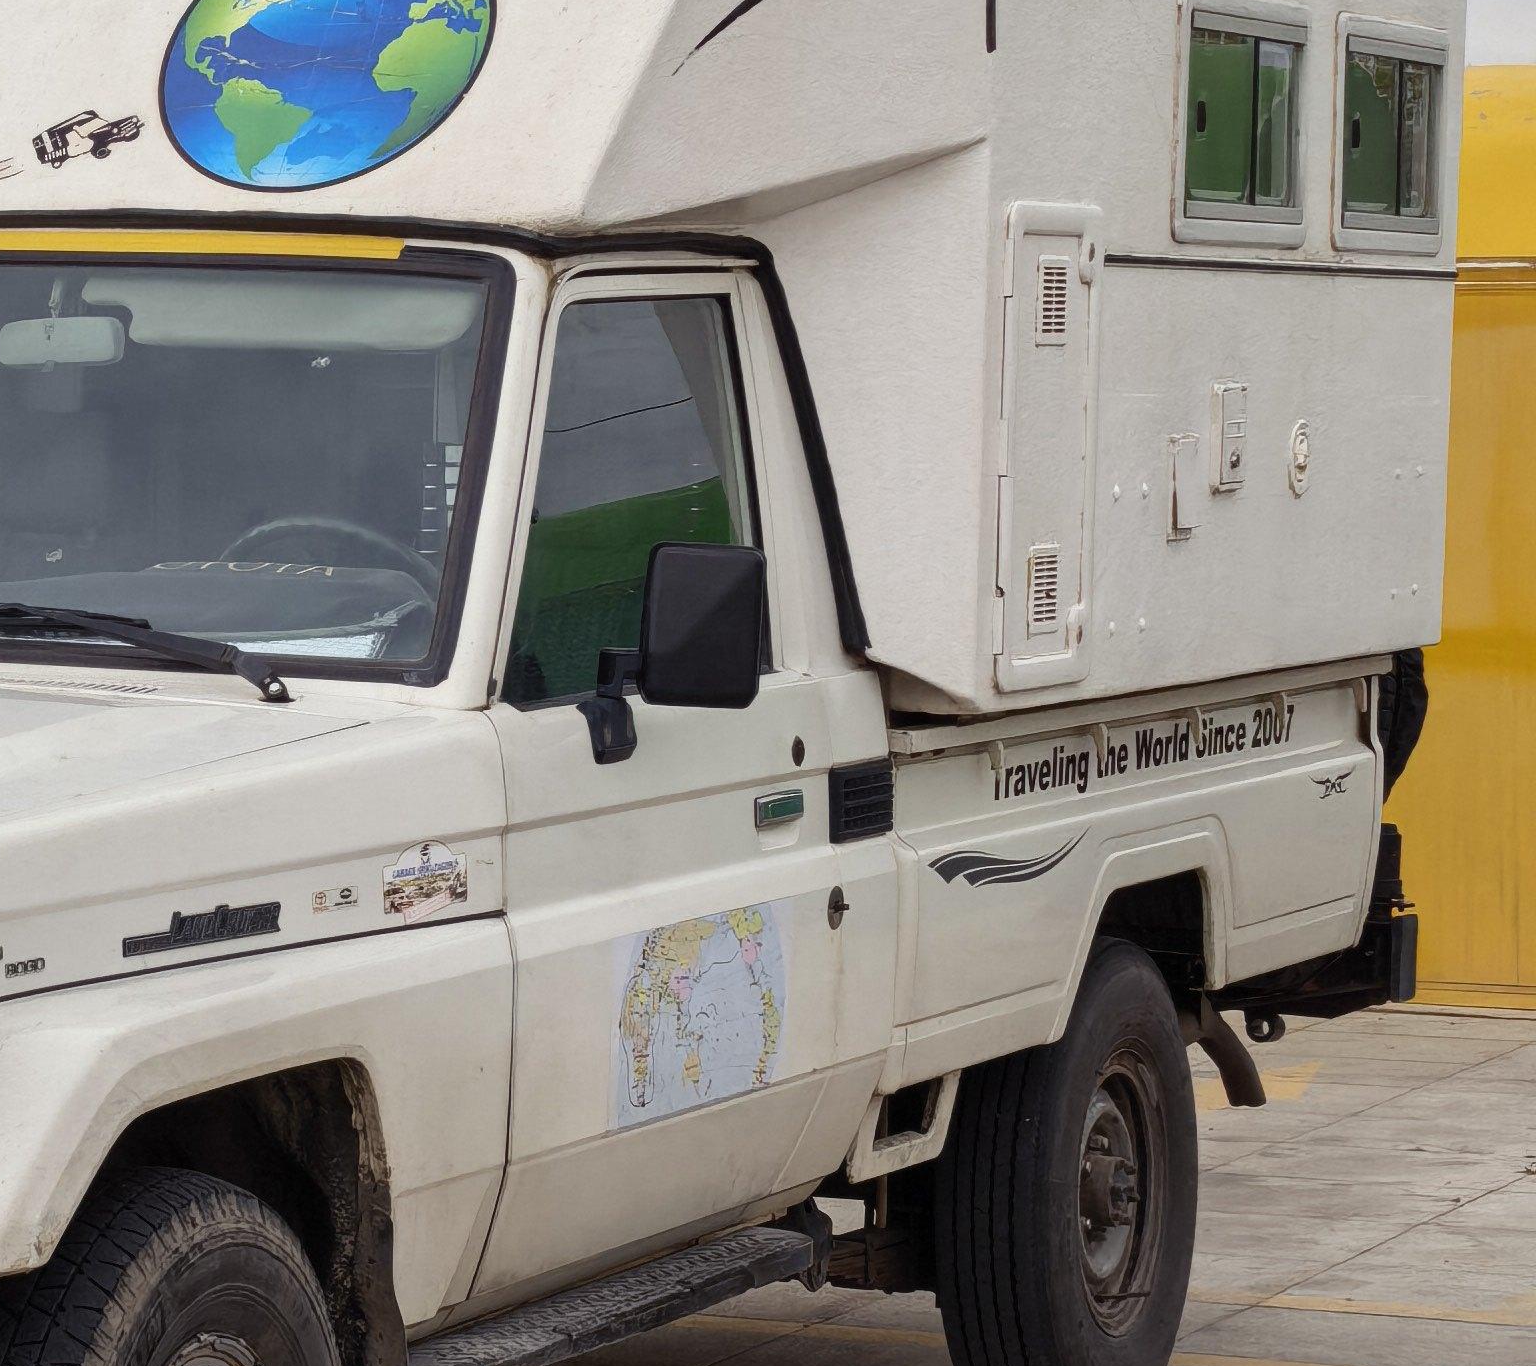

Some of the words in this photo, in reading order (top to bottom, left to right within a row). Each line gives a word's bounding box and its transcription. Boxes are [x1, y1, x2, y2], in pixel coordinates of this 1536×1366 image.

[1135, 718, 1191, 771] World
[1195, 717, 1247, 759] Since
[1251, 704, 1295, 749] 2007
